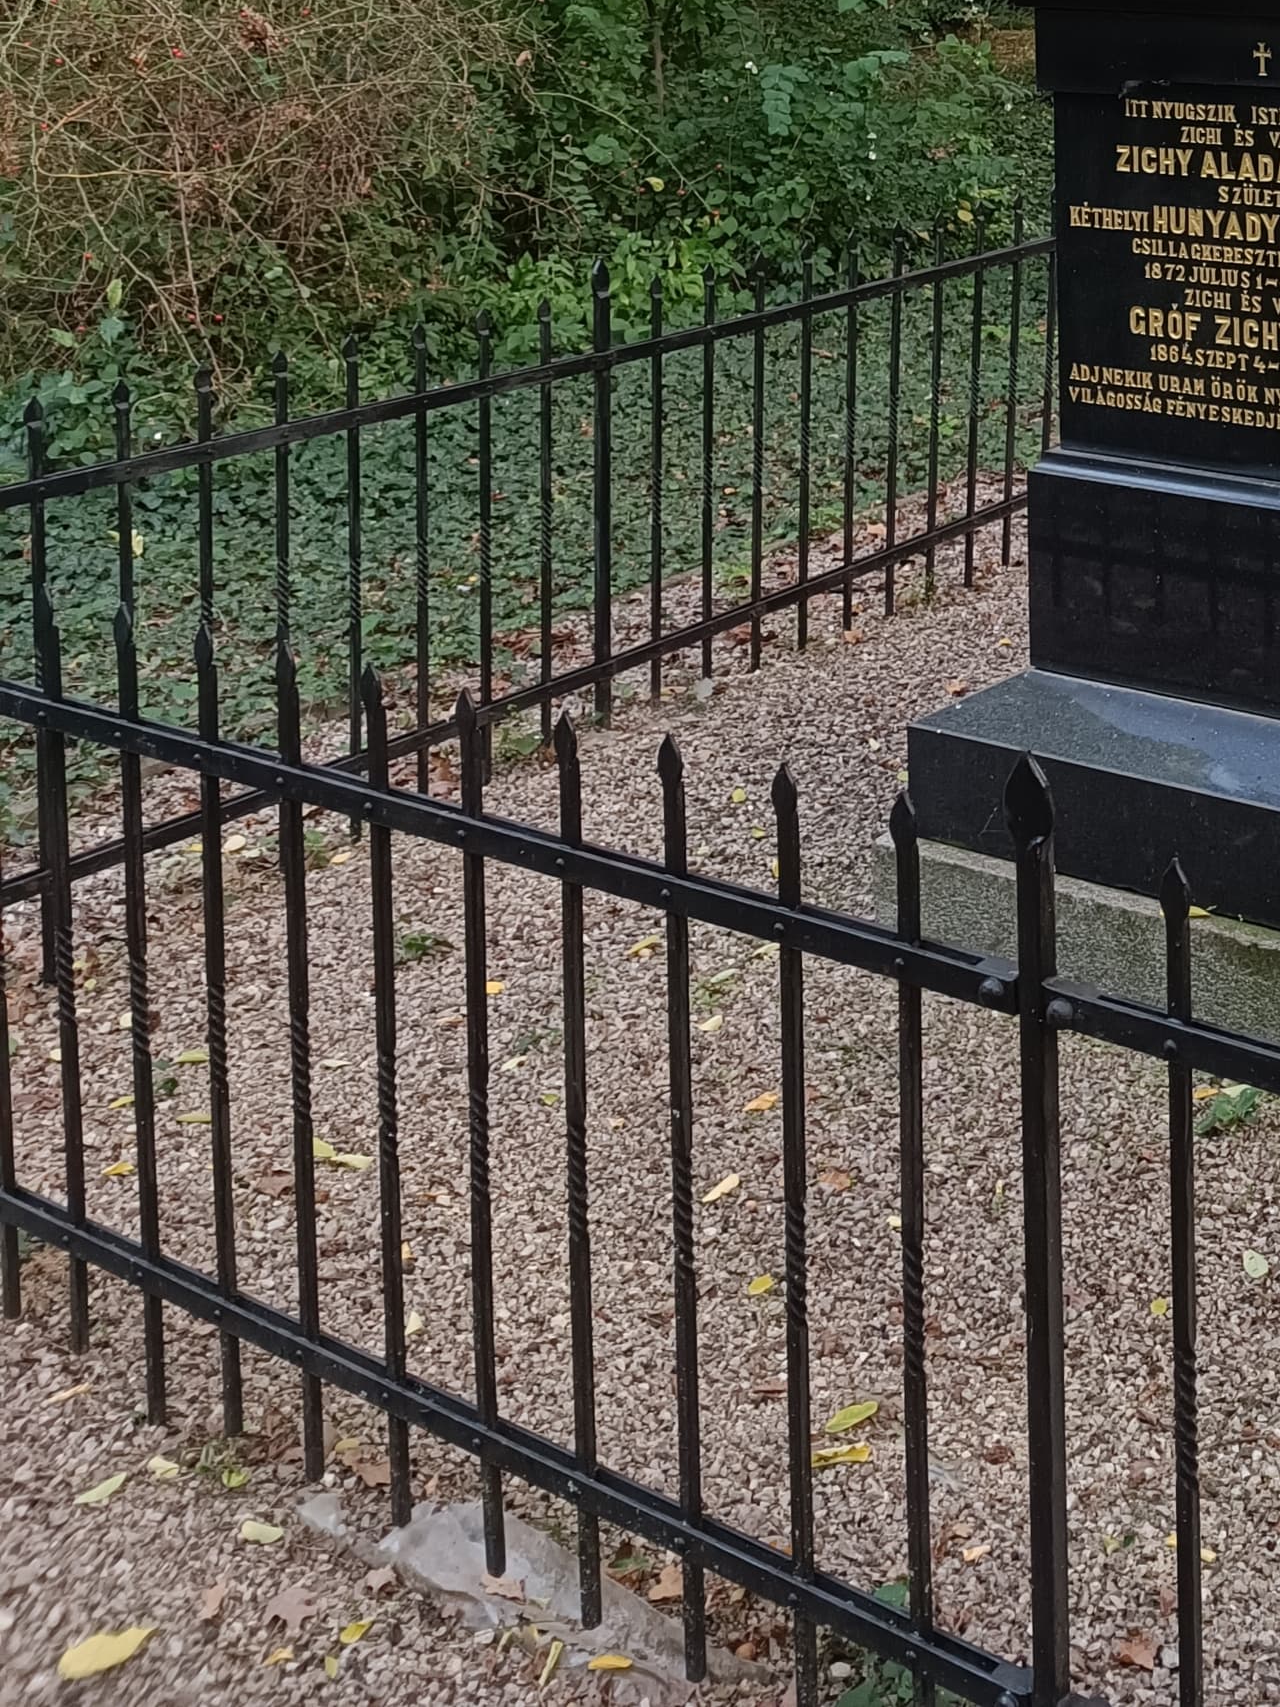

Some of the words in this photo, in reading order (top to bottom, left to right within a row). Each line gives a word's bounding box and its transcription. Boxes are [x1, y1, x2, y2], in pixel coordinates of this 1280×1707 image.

[1124, 98, 1148, 118] ITT
[1152, 100, 1237, 123] NYUGSZIK
[1180, 126, 1222, 145] ZICHI
[1233, 123, 1255, 147] ÉS
[1115, 144, 1194, 176] ZICHY
[1069, 201, 1149, 232] KÉTHELYI
[1152, 205, 1280, 244] HUNYADY
[1144, 261, 1186, 282] 1872
[1188, 263, 1250, 289] JÚLIUS
[1184, 288, 1231, 311] ZICHI
[1240, 289, 1262, 313] ÉS
[1129, 303, 1202, 341] GRÓF
[1150, 342, 1193, 365] 1864
[1194, 348, 1249, 372] SZEPT
[1069, 362, 1099, 383] ADJ
[1101, 367, 1154, 391] NEKIK
[1158, 374, 1206, 397] URAM
[1211, 375, 1259, 403] ÖRÖK
[1068, 385, 1162, 413] VILÁGOSSÁG
